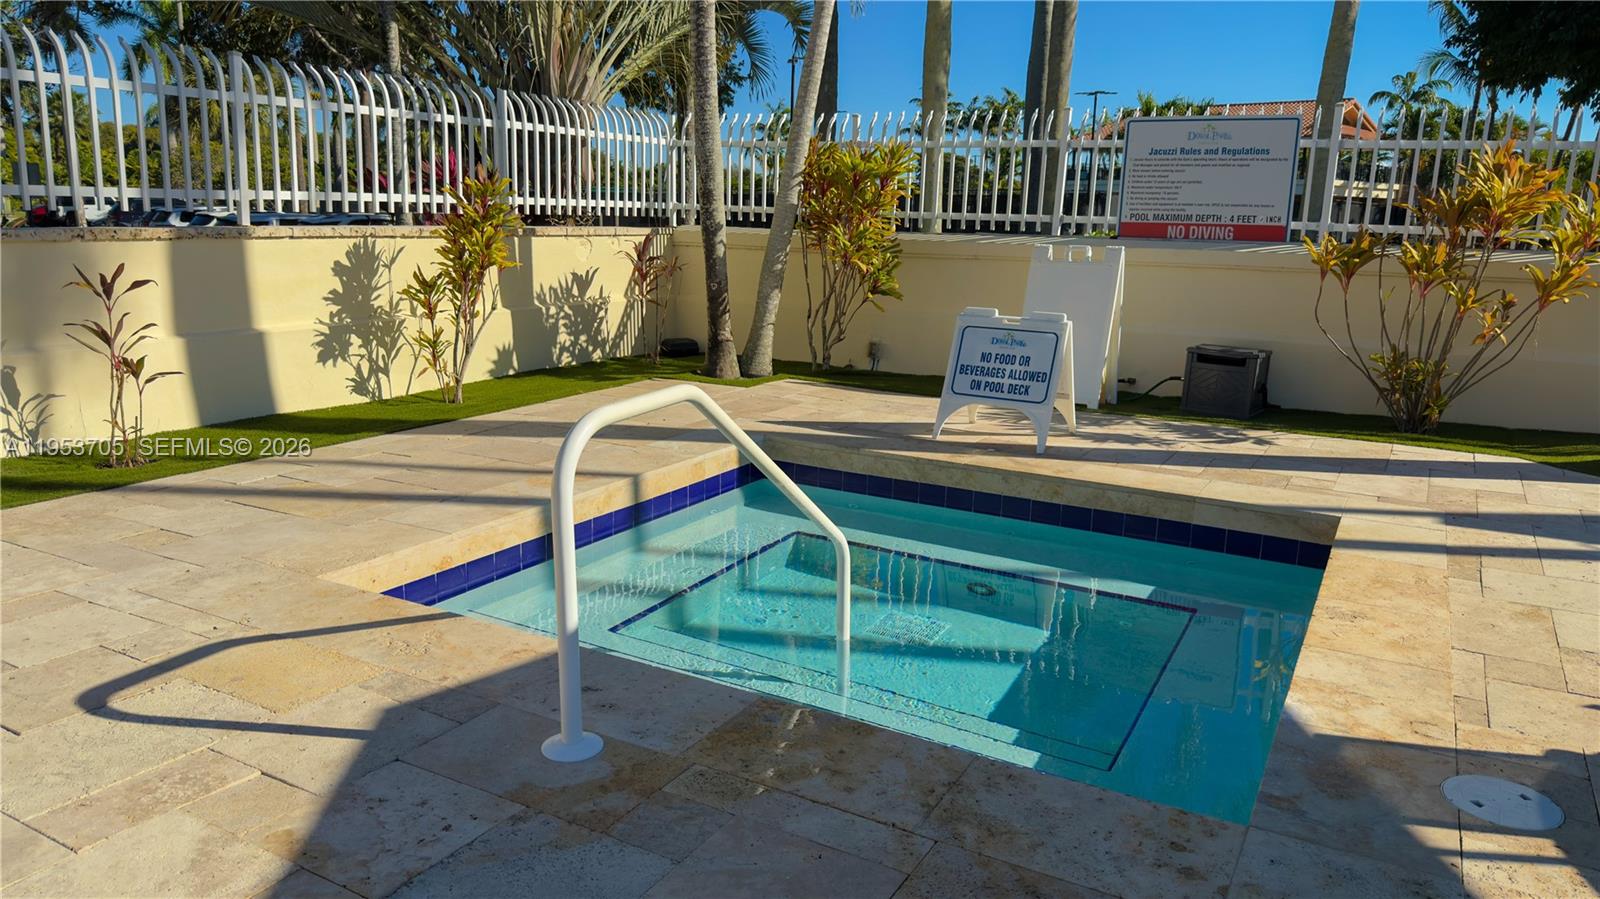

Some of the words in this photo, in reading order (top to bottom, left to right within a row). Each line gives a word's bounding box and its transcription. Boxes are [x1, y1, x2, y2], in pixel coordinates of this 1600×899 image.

[1149, 147, 1178, 156] Jacuzzi
[1179, 147, 1202, 155] Rules
[1203, 147, 1219, 155] and
[1221, 147, 1270, 157] Regulations
[1129, 213, 1150, 222] POOL
[1152, 214, 1193, 222] MAXIMUM
[1196, 214, 1222, 223] DEPTH
[1229, 215, 1235, 223] 4
[1236, 215, 1257, 223] FEET
[1167, 224, 1185, 239] NO
[1189, 225, 1234, 240] DIVING
[980, 352, 992, 363] NO
[994, 353, 1016, 365] FOOD
[1018, 355, 1031, 366] OR
[959, 364, 1006, 379] BEVERAGES
[1008, 370, 1048, 383] ALLOWED
[970, 379, 982, 391] ON
[983, 381, 1005, 393] POOL
[1007, 384, 1031, 396] DECK
